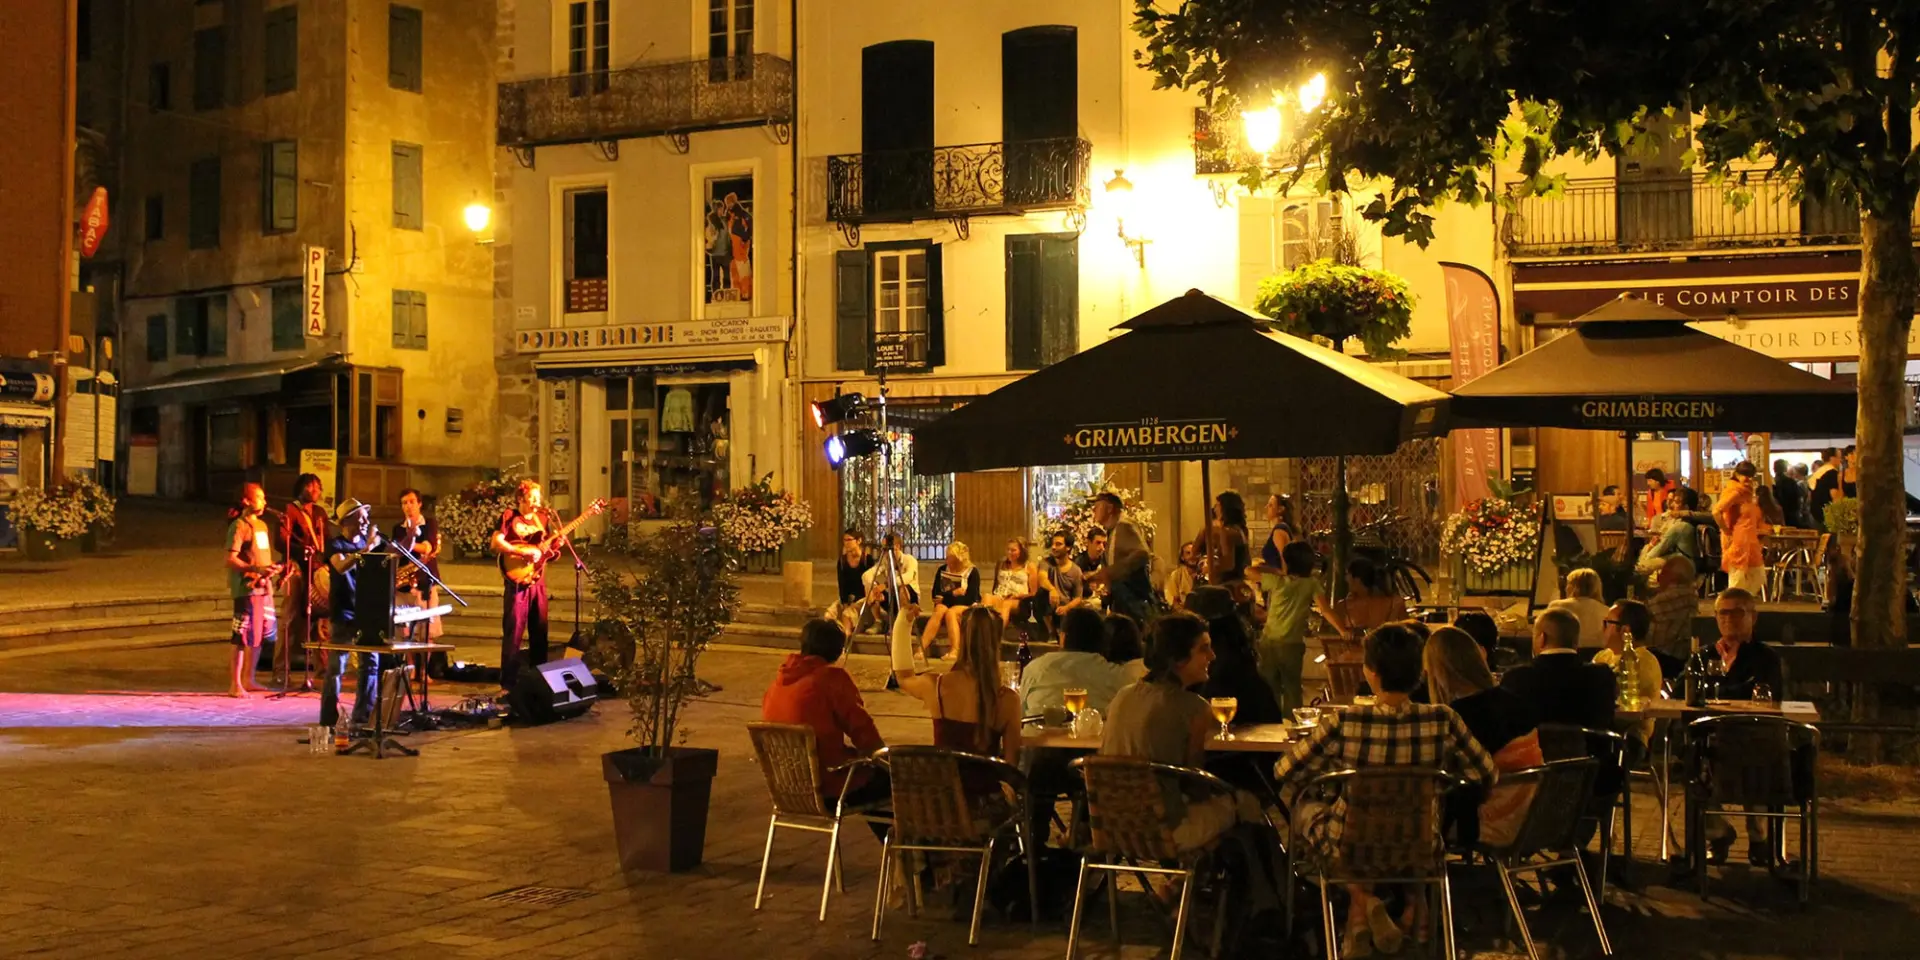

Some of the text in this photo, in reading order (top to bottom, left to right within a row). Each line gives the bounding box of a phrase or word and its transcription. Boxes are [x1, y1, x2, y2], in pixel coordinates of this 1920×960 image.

[84, 196, 104, 248] TABAC
[310, 251, 321, 332] PIZZA
[1676, 288, 1799, 306] COMPTOIR
[1810, 286, 1849, 301] DES
[711, 319, 749, 328] LOCATION
[519, 325, 674, 349] POUDRE BLANCHE
[1813, 330, 1853, 347] DES
[1581, 402, 1716, 418] GRIMBERGEN
[1140, 417, 1159, 426] 1128
[1074, 423, 1228, 448] GRIMBERGEN
